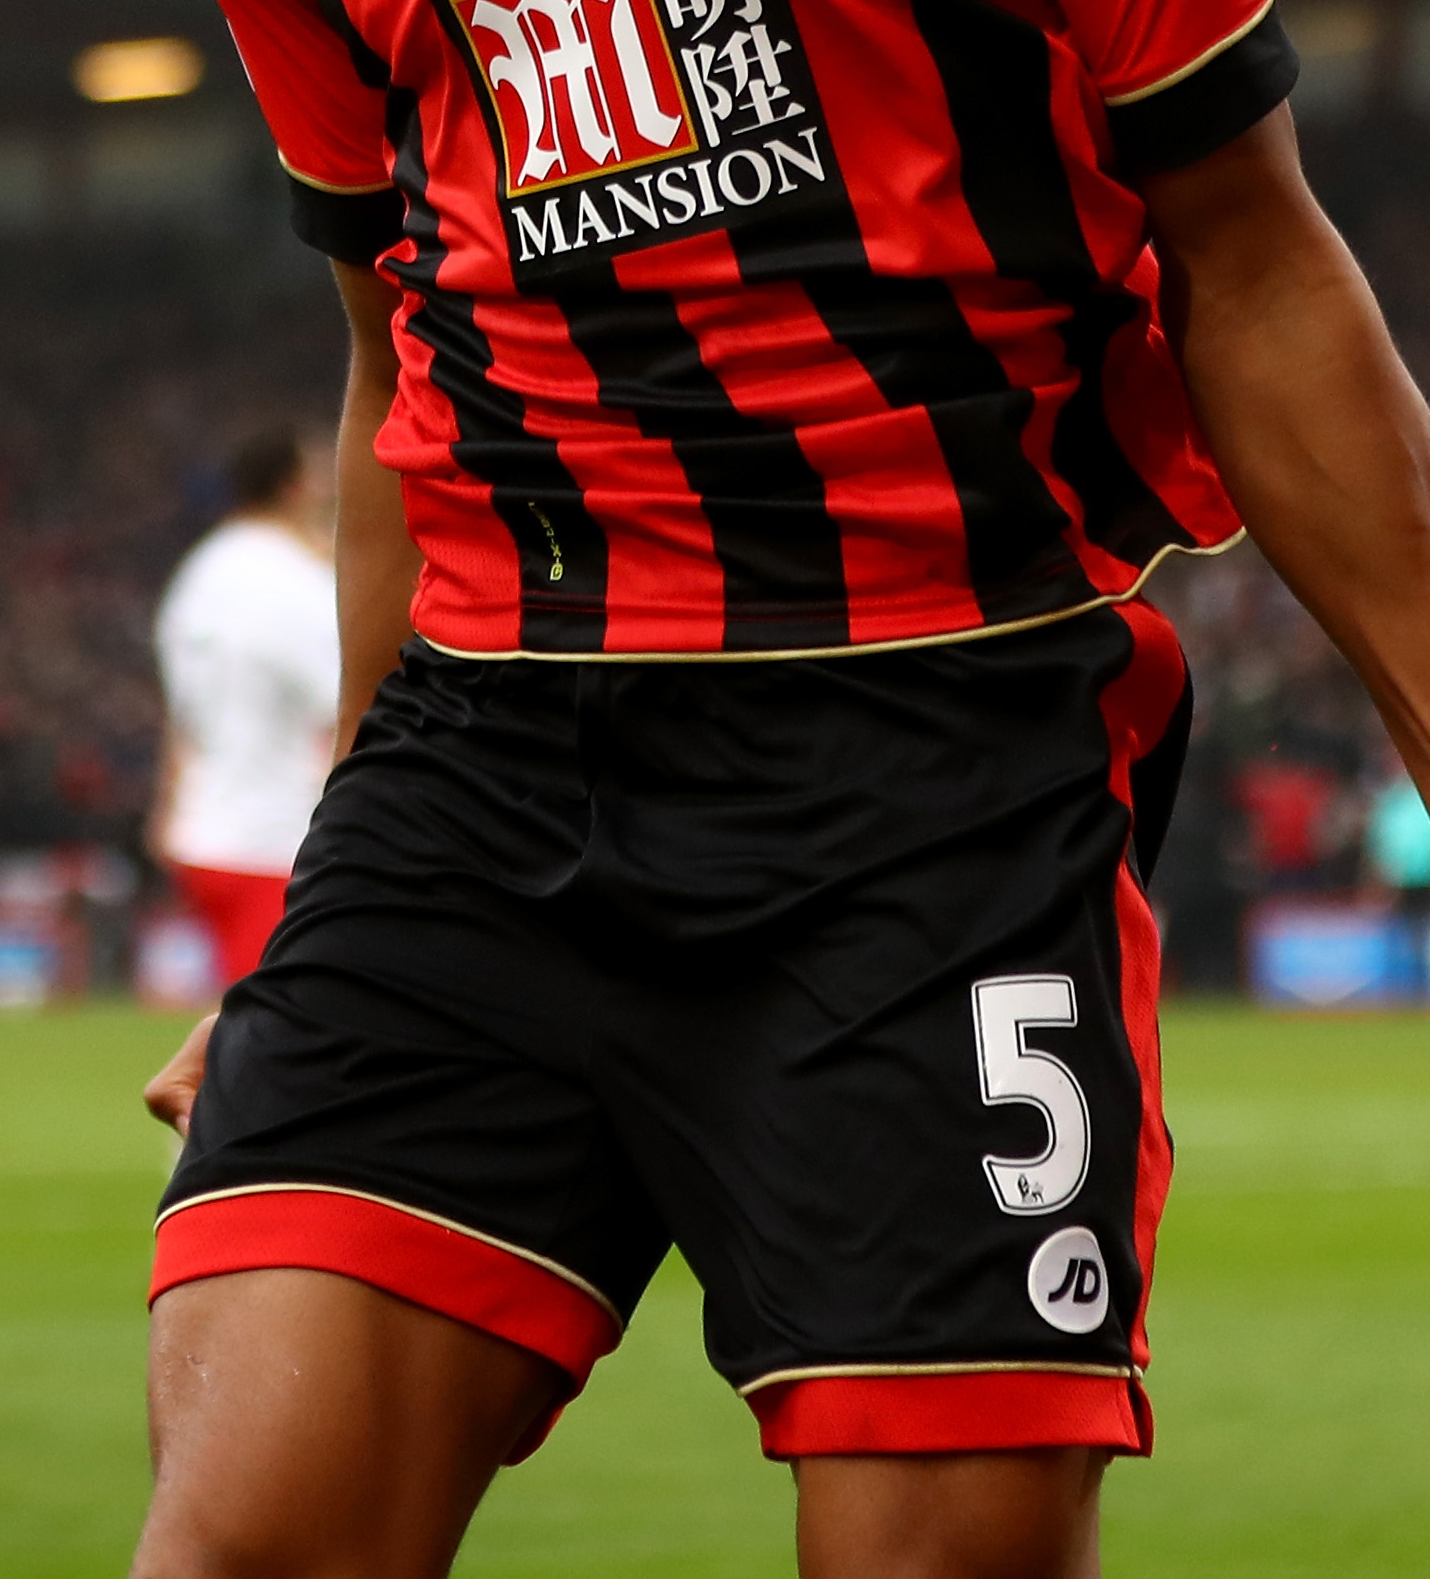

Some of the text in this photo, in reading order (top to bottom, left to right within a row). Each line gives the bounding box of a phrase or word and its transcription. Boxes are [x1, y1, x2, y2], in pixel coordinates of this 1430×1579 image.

[511, 126, 826, 263] MANSION
[972, 974, 1091, 1216] 5
[1048, 1259, 1101, 1303] JD
